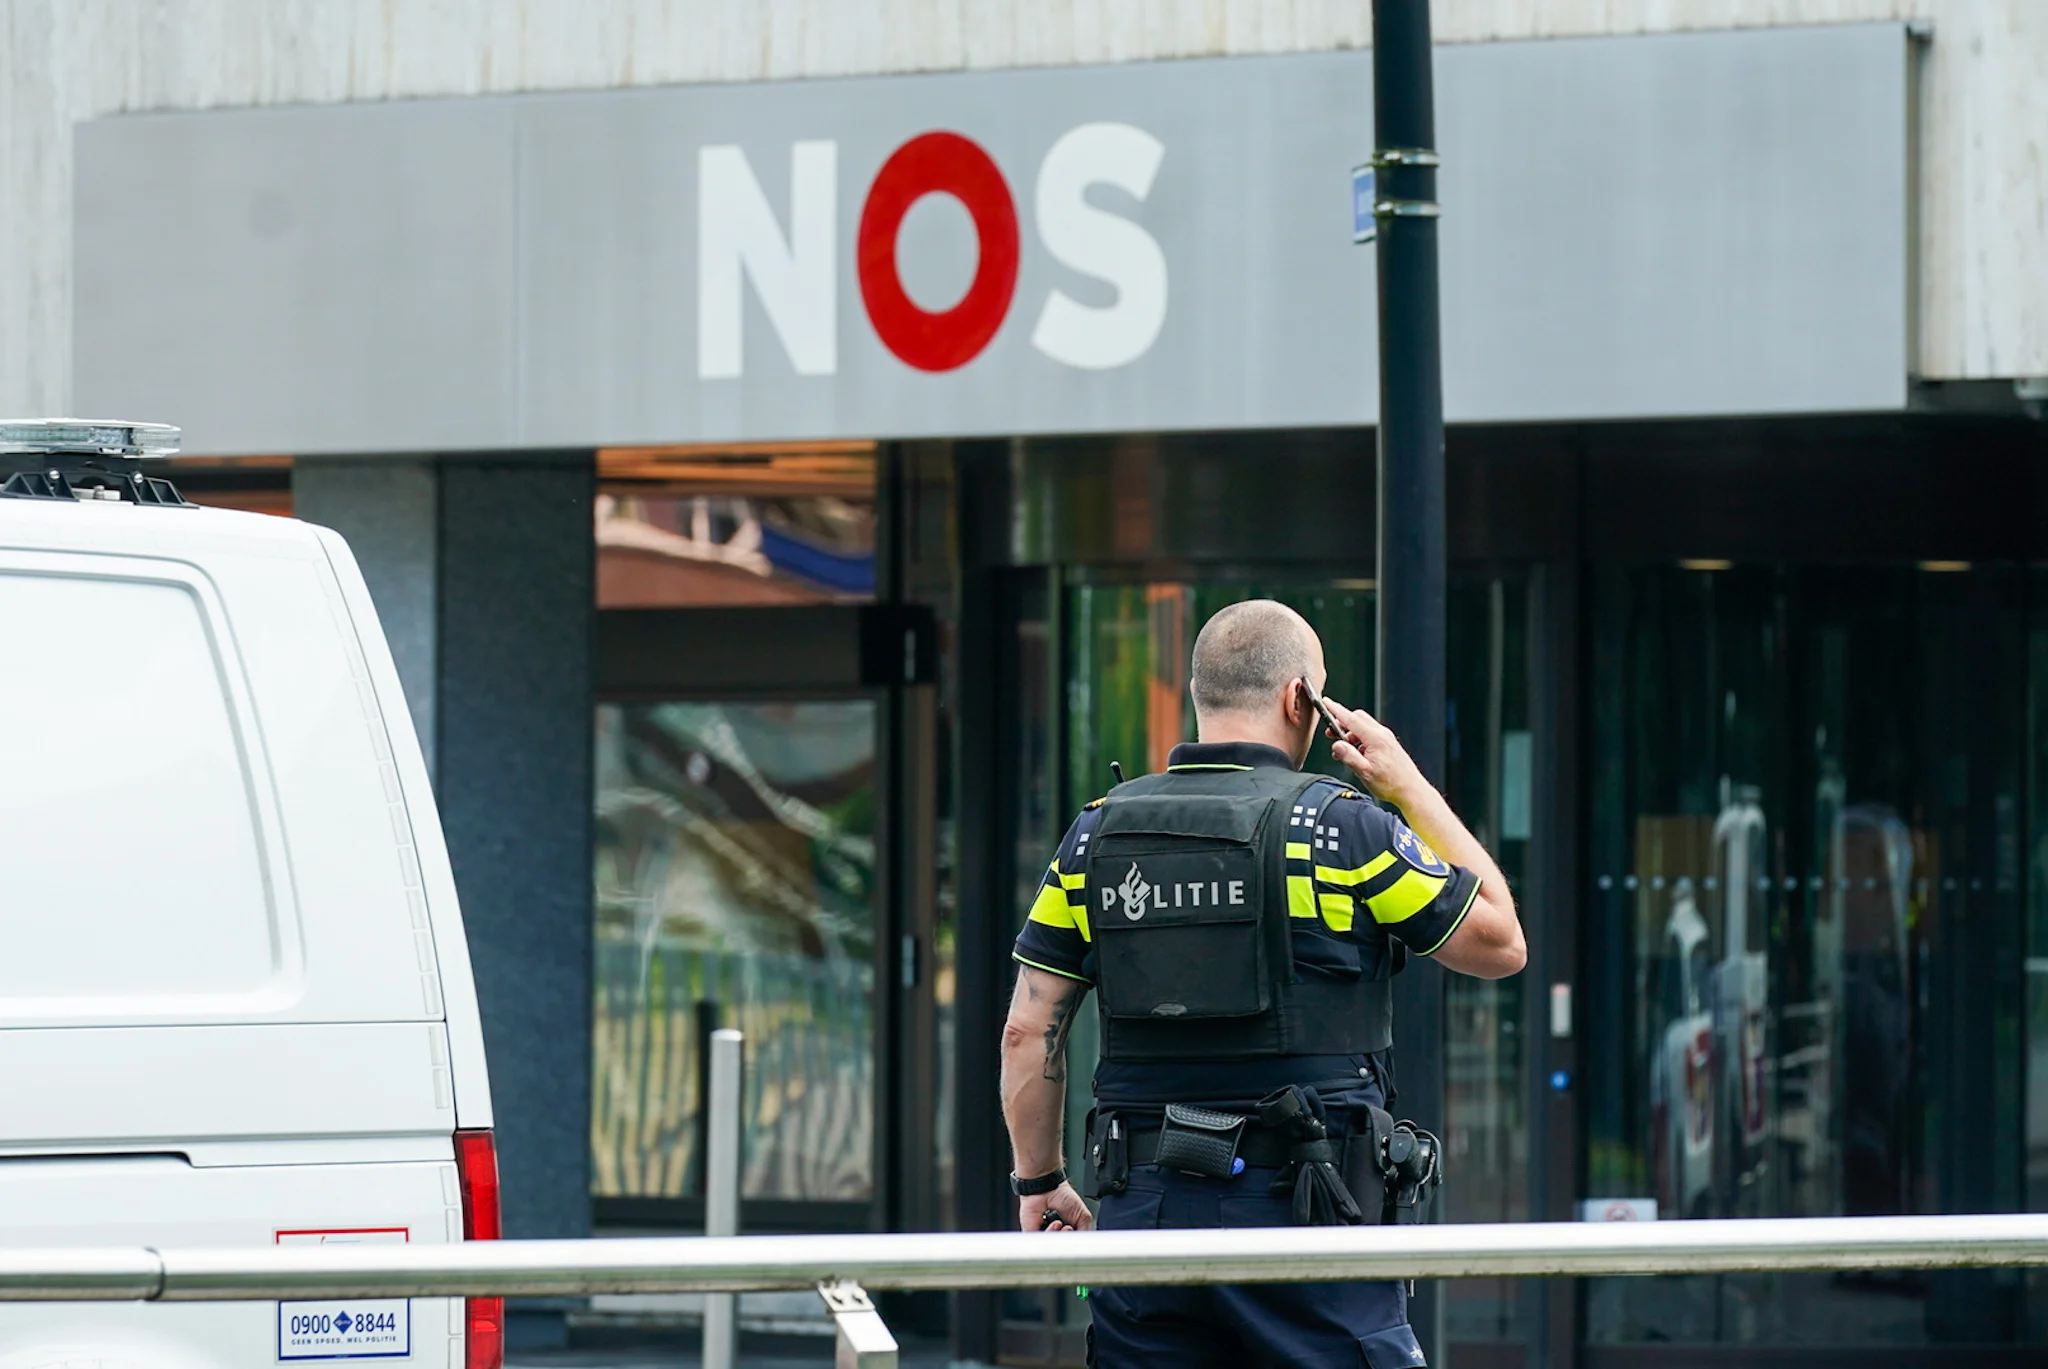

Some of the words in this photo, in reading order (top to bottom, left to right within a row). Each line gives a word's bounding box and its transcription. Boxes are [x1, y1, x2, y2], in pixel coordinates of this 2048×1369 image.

[698, 121, 1168, 379] NOS
[1101, 879, 1245, 921] POLITIE
[291, 1314, 331, 1335] 0900
[355, 1312, 396, 1333] 8844
[366, 1335, 397, 1343] POLITIE
